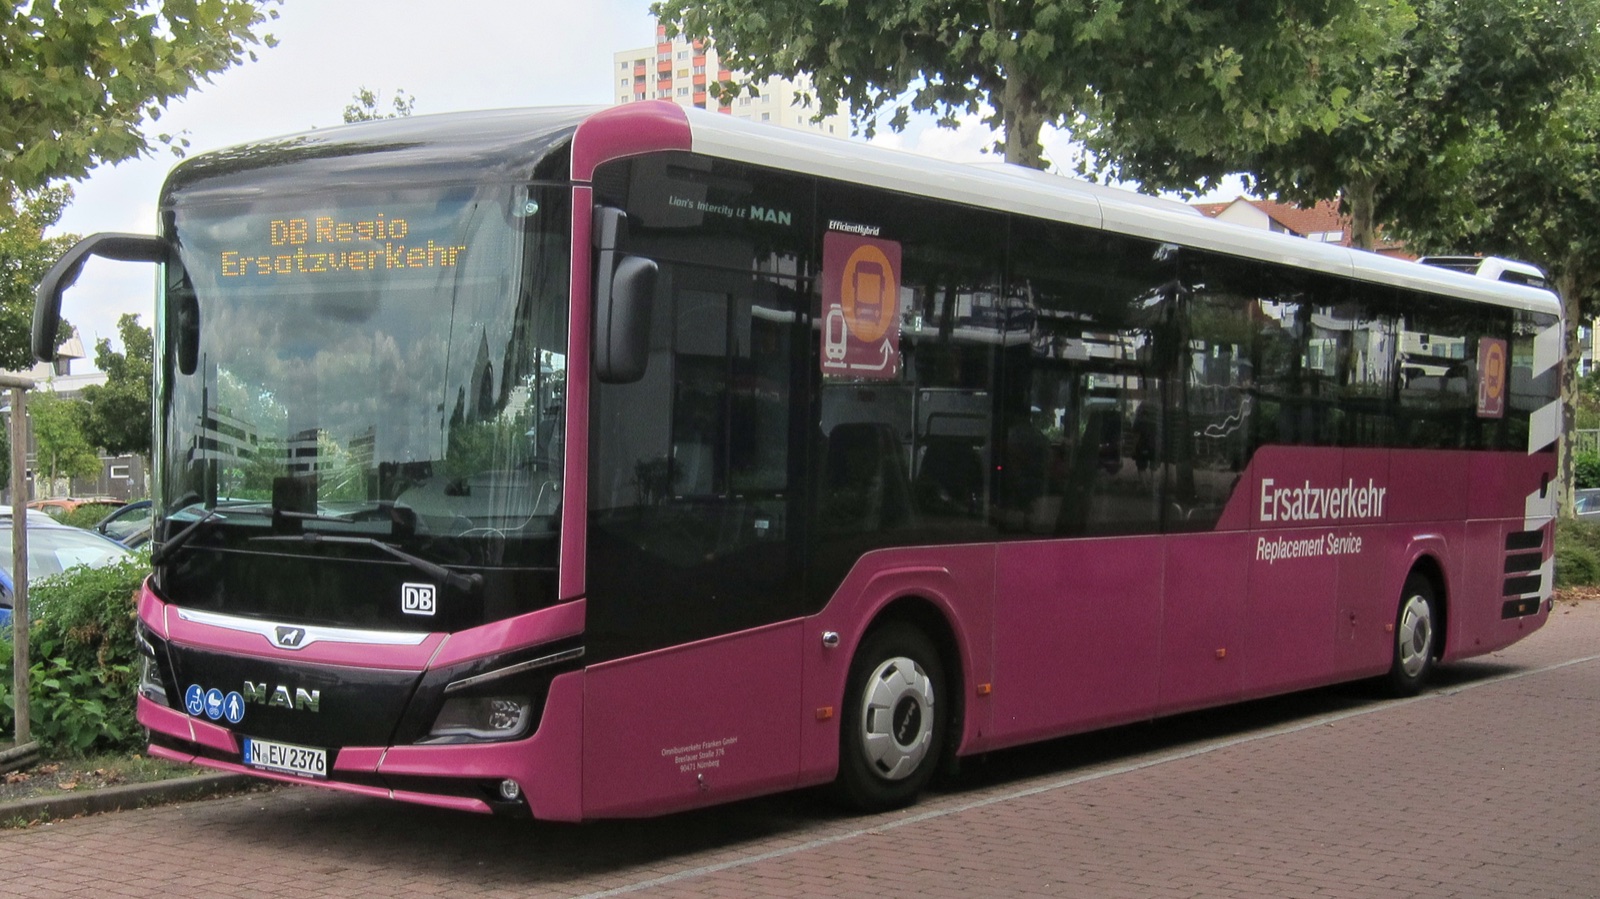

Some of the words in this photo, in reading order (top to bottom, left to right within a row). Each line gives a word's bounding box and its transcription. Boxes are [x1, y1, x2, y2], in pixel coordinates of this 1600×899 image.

[669, 195, 694, 209] Lion's
[697, 201, 733, 218] Intercity
[736, 208, 747, 218] LE
[750, 205, 792, 226] MAN
[270, 218, 309, 246] DB
[316, 213, 408, 243] Regio
[828, 220, 880, 236] EfficientHybrid
[221, 240, 467, 277] Ersatzverkehr
[1260, 478, 1386, 521] Ersatzverkehr
[1256, 534, 1325, 565] Replacement
[1326, 532, 1362, 556] Service
[405, 586, 433, 611] DB
[243, 681, 320, 713] MAN
[252, 742, 261, 762] N
[269, 745, 287, 766] EV
[290, 748, 325, 772] 2376
[702, 741, 721, 749] Franken
[722, 737, 738, 746] GmbH
[675, 755, 698, 764] Breslauer
